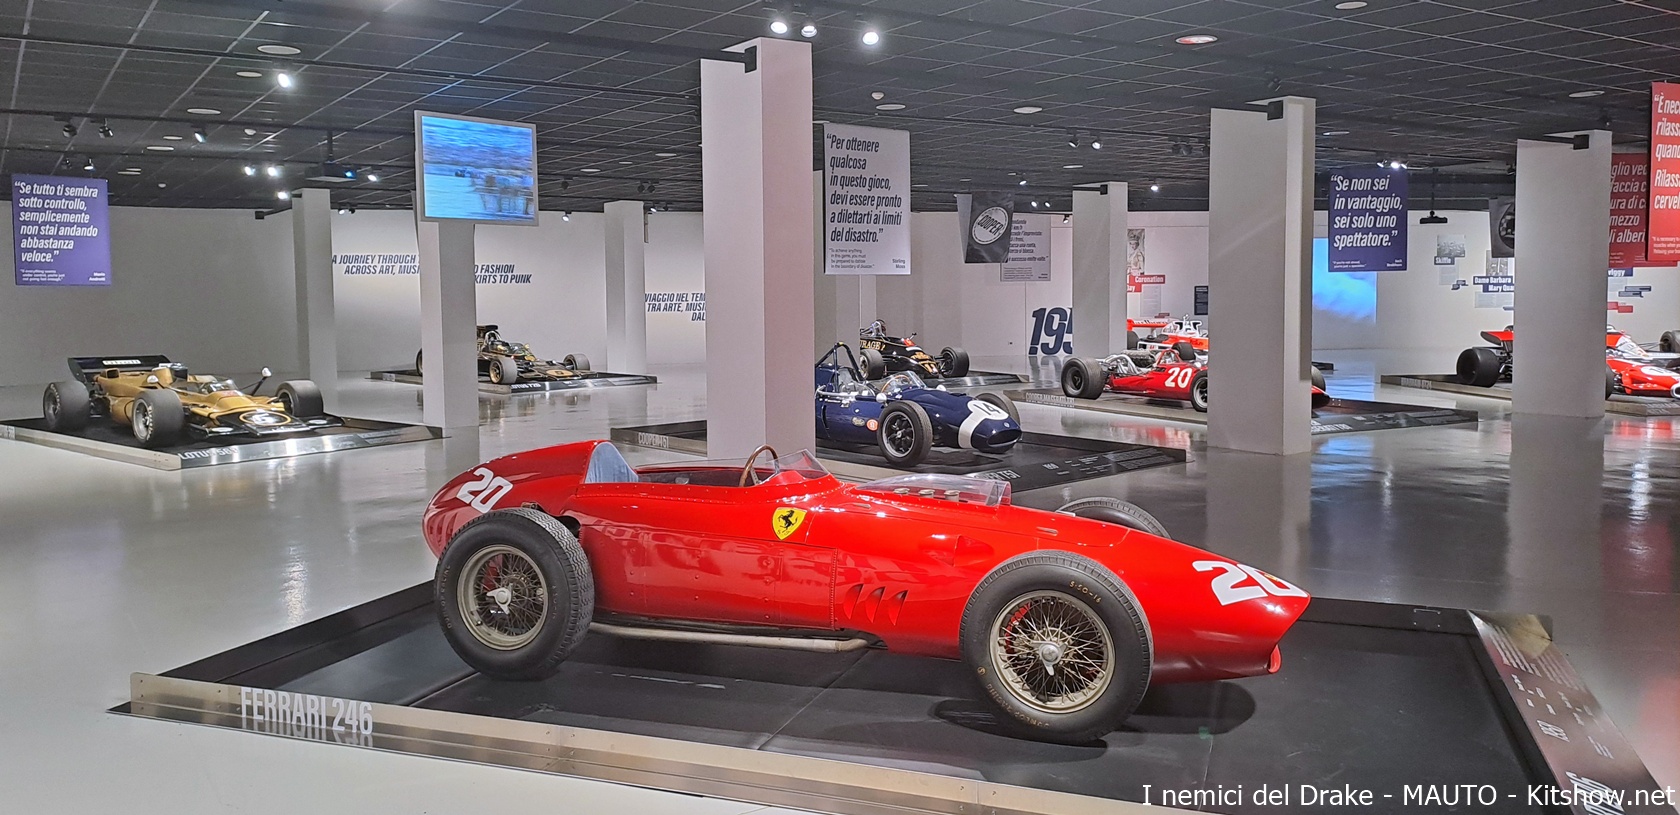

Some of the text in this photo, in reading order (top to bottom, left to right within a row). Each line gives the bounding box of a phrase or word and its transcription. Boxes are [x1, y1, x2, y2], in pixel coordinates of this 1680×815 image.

[1664, 100, 1680, 114] nec
[1656, 118, 1680, 136] rilass
[827, 134, 879, 152] “Per ottenere
[830, 154, 866, 171] qualcosa
[830, 172, 891, 191] in questo gioco,
[1331, 175, 1390, 191] “Se non sei
[1654, 169, 1680, 187] Rilass
[15, 181, 98, 197] “Se tutto ti sembra
[19, 197, 87, 211] sotto controllo,
[830, 191, 902, 209] devi essere pronto
[1334, 193, 1402, 212] in vantaggio,
[19, 210, 90, 223] semplicemente
[830, 209, 902, 225] a dilettarti ai limiti
[1334, 212, 1396, 228] sei solo uno
[20, 224, 98, 236] non stai andando
[831, 227, 883, 242] del disastro.”
[21, 237, 73, 249] abbastanza
[1334, 230, 1398, 250] spettatore.”
[22, 250, 59, 262] veloce.”
[339, 255, 376, 264] JOURNEY
[378, 255, 416, 264] THROUGH
[480, 264, 514, 273] FASHION
[344, 265, 377, 274] ACROSS
[378, 265, 395, 275] ART,
[499, 275, 508, 283] TO
[510, 274, 532, 283] PUNK
[645, 293, 674, 302] VIAGGIO
[676, 293, 689, 302] NEL
[648, 303, 706, 312] TRA ARTE, MUSI
[1165, 367, 1192, 388] 20
[973, 403, 1001, 415] 14
[456, 467, 513, 513] 20
[1192, 561, 1308, 606] 20
[241, 687, 373, 734] FERRARI 246
